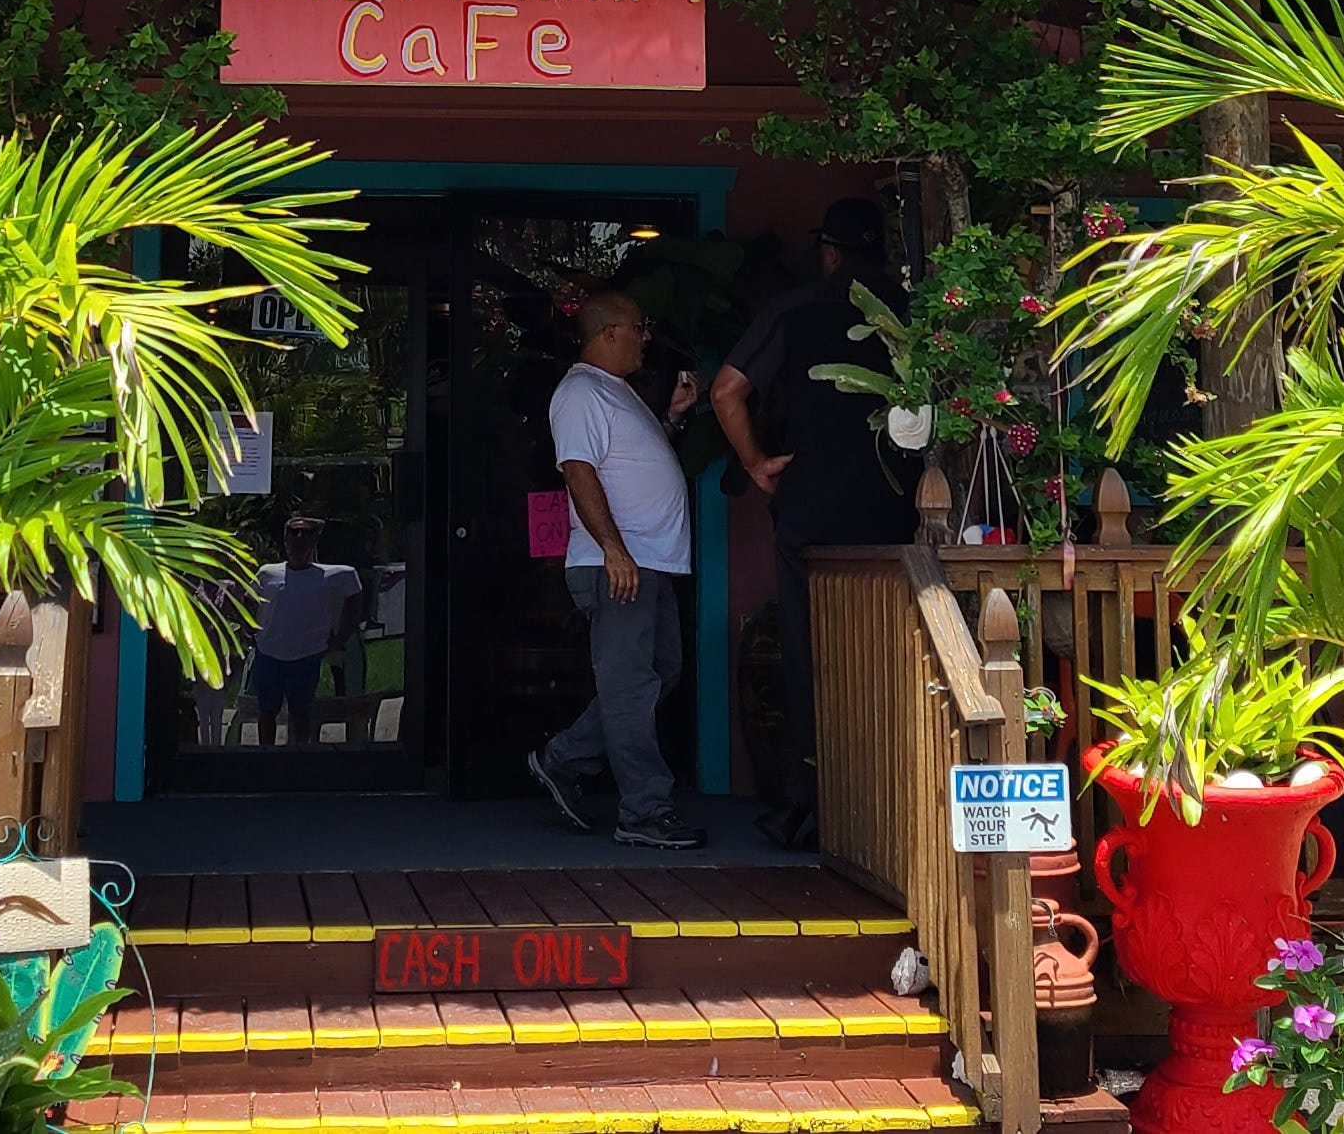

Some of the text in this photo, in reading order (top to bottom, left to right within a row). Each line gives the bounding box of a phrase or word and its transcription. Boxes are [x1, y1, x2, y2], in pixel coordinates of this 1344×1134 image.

[533, 493, 569, 512] CAS
[960, 773, 1060, 799] NOTICE
[963, 806, 1011, 818] WATCH
[969, 820, 1006, 832] YOUR
[970, 833, 1005, 846] STEP
[379, 932, 629, 988] CASH ONLY
